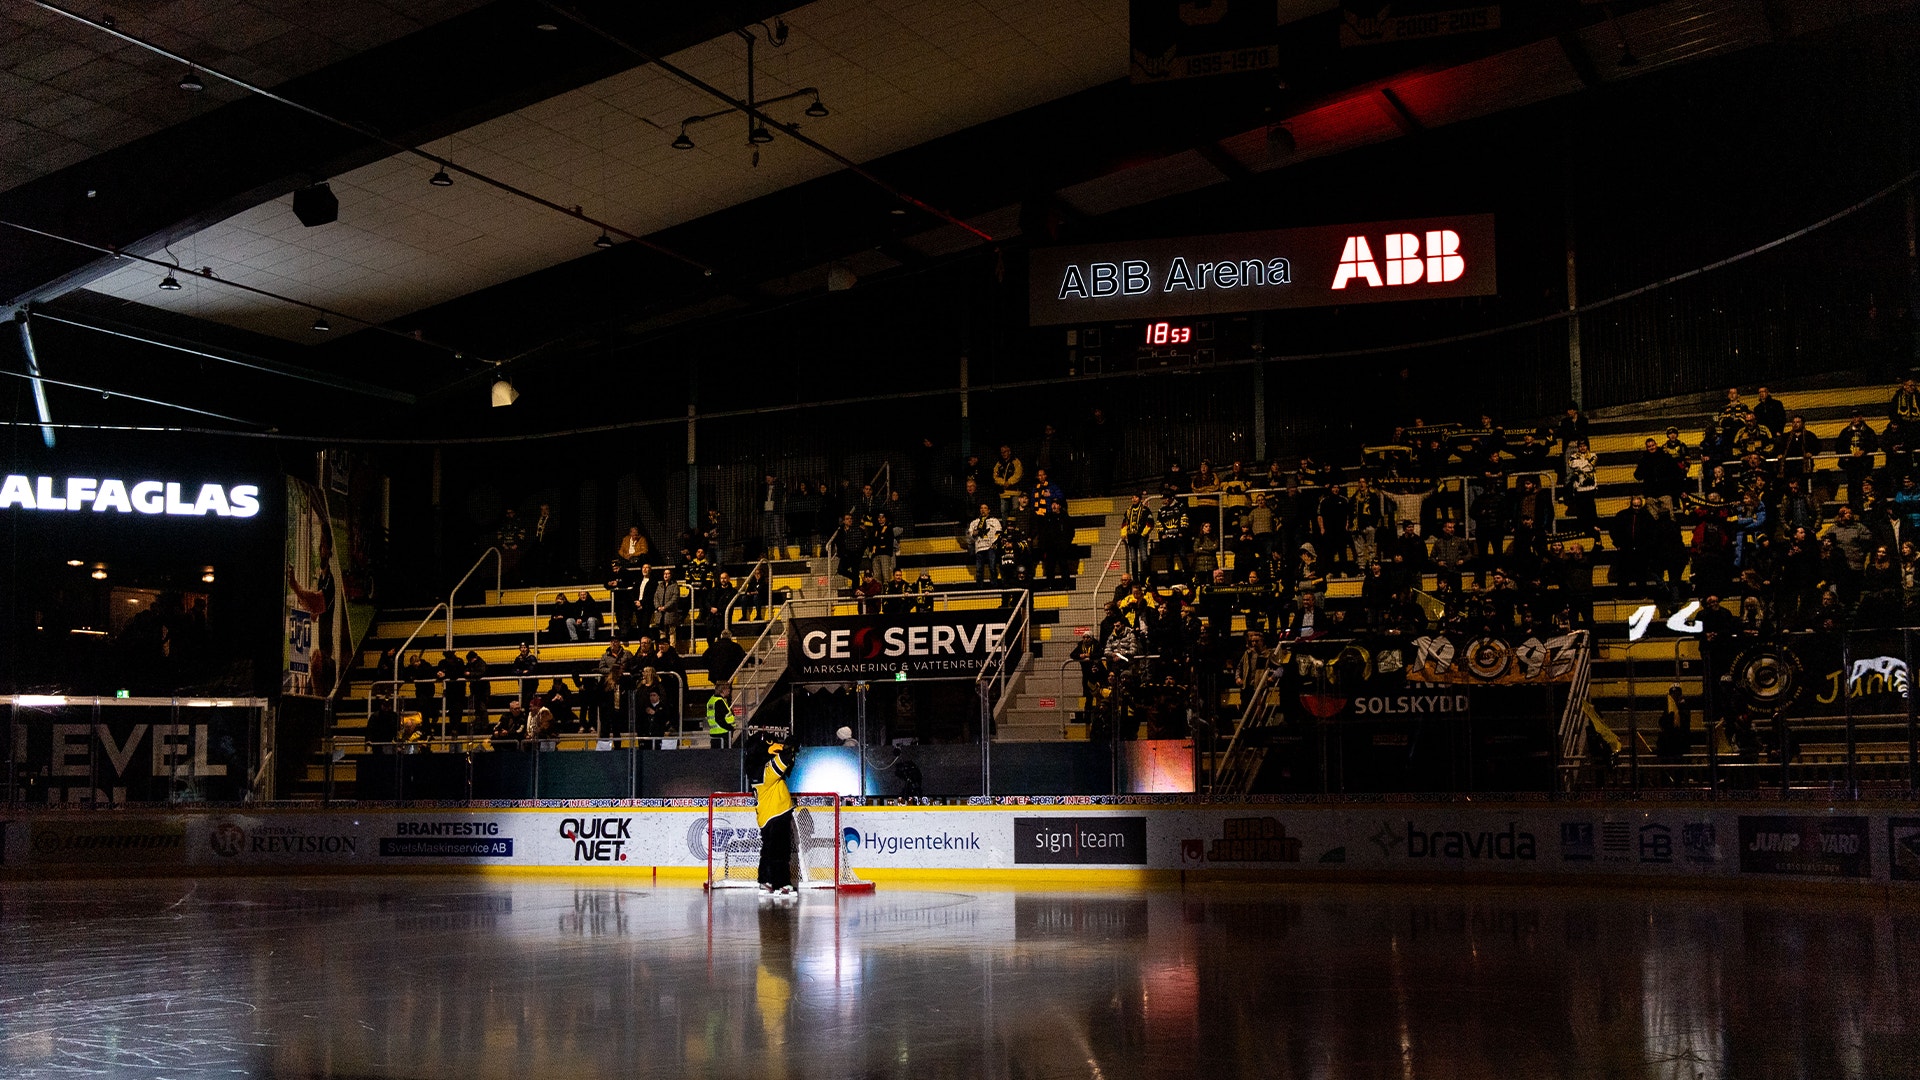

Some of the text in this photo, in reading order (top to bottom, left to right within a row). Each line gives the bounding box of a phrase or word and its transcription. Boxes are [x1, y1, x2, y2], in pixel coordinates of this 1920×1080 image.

[1331, 230, 1465, 290] ABB
[1058, 257, 1292, 299] ABB Arena
[0, 475, 260, 518] ALFAGLAS
[803, 659, 1004, 674] MARKSANERING & VATTENRENNG
[1354, 695, 1469, 715] SOLSKYDD
[397, 822, 499, 836] BRANTESTIG
[560, 818, 632, 842] QUICK
[1035, 828, 1125, 852] sign team
[1408, 821, 1536, 859] bravida
[251, 836, 357, 852] REVISION
[491, 843, 507, 853] AB
[865, 832, 980, 854] Hygienteknik
